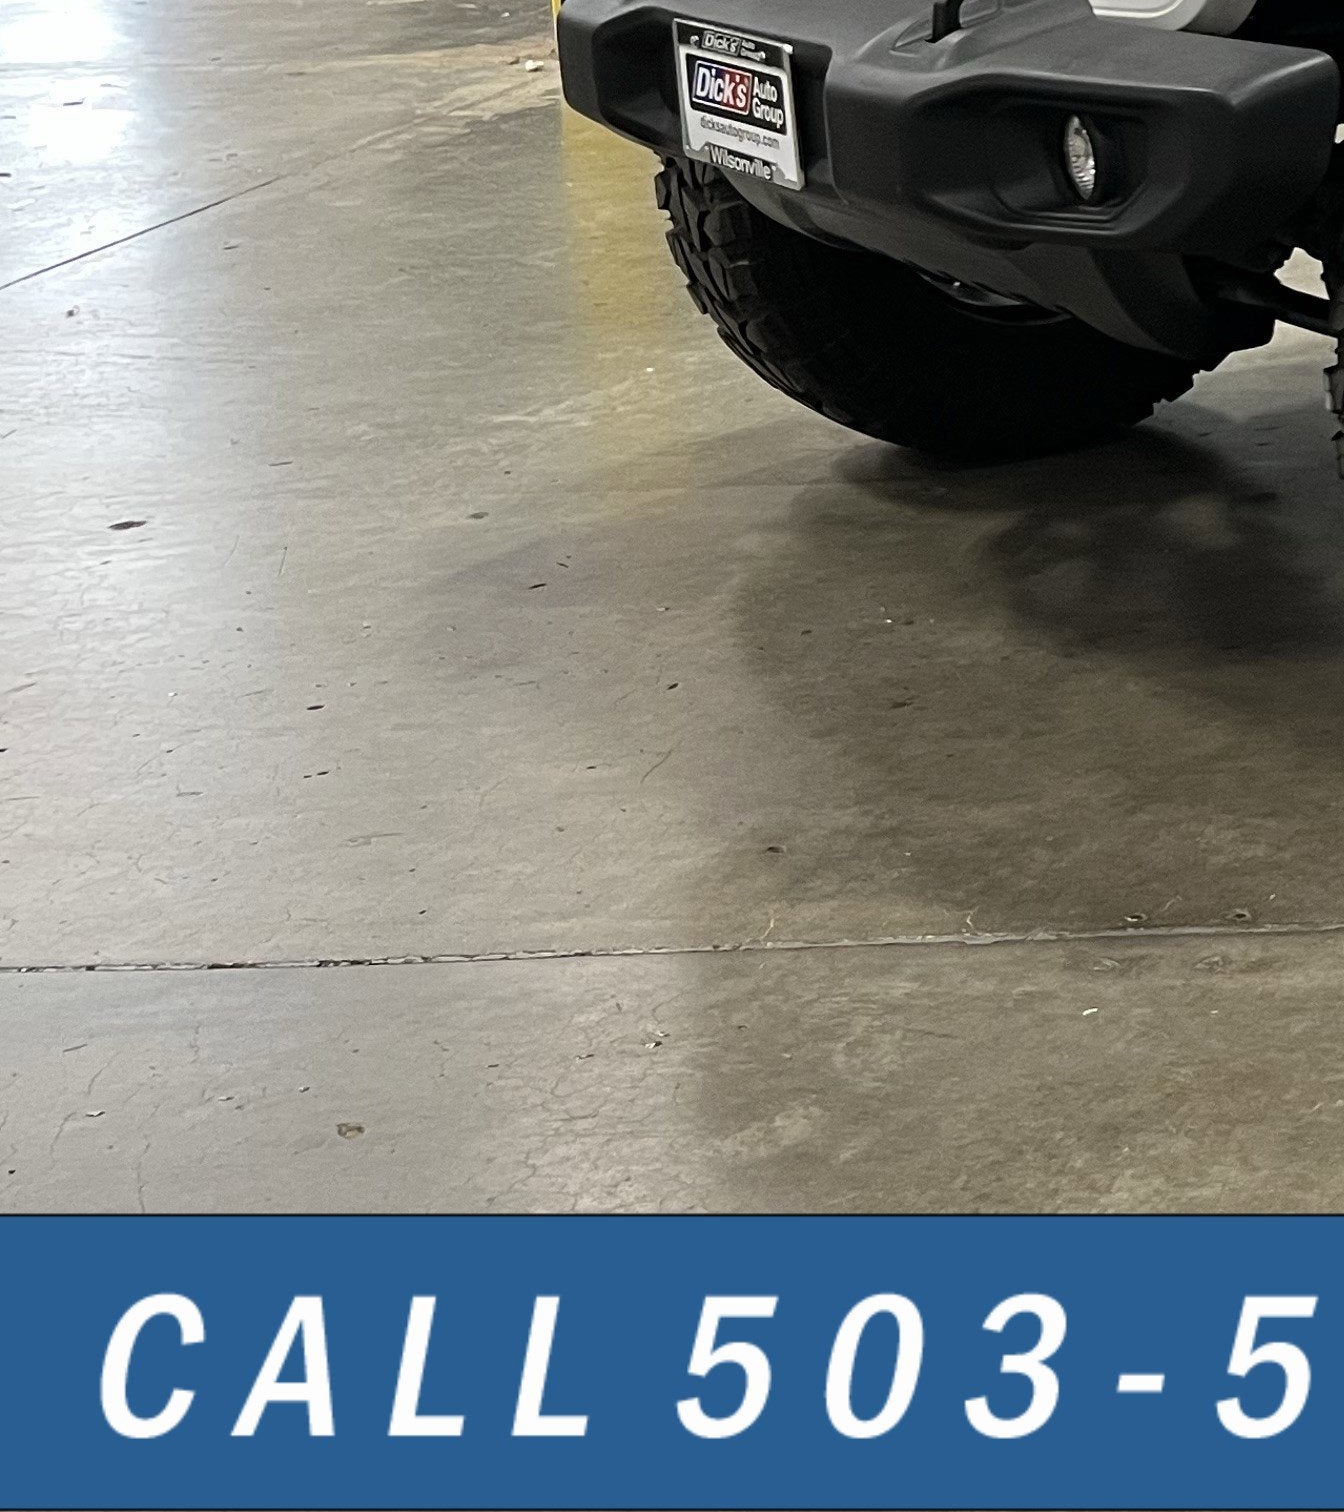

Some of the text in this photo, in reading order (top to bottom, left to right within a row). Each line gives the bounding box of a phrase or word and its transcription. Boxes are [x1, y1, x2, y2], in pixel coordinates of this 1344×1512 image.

[704, 33, 739, 53] Dick's
[697, 66, 747, 108] Dick's
[752, 76, 779, 104] Auto
[751, 97, 785, 130] Group
[710, 147, 771, 179] Wilsonville
